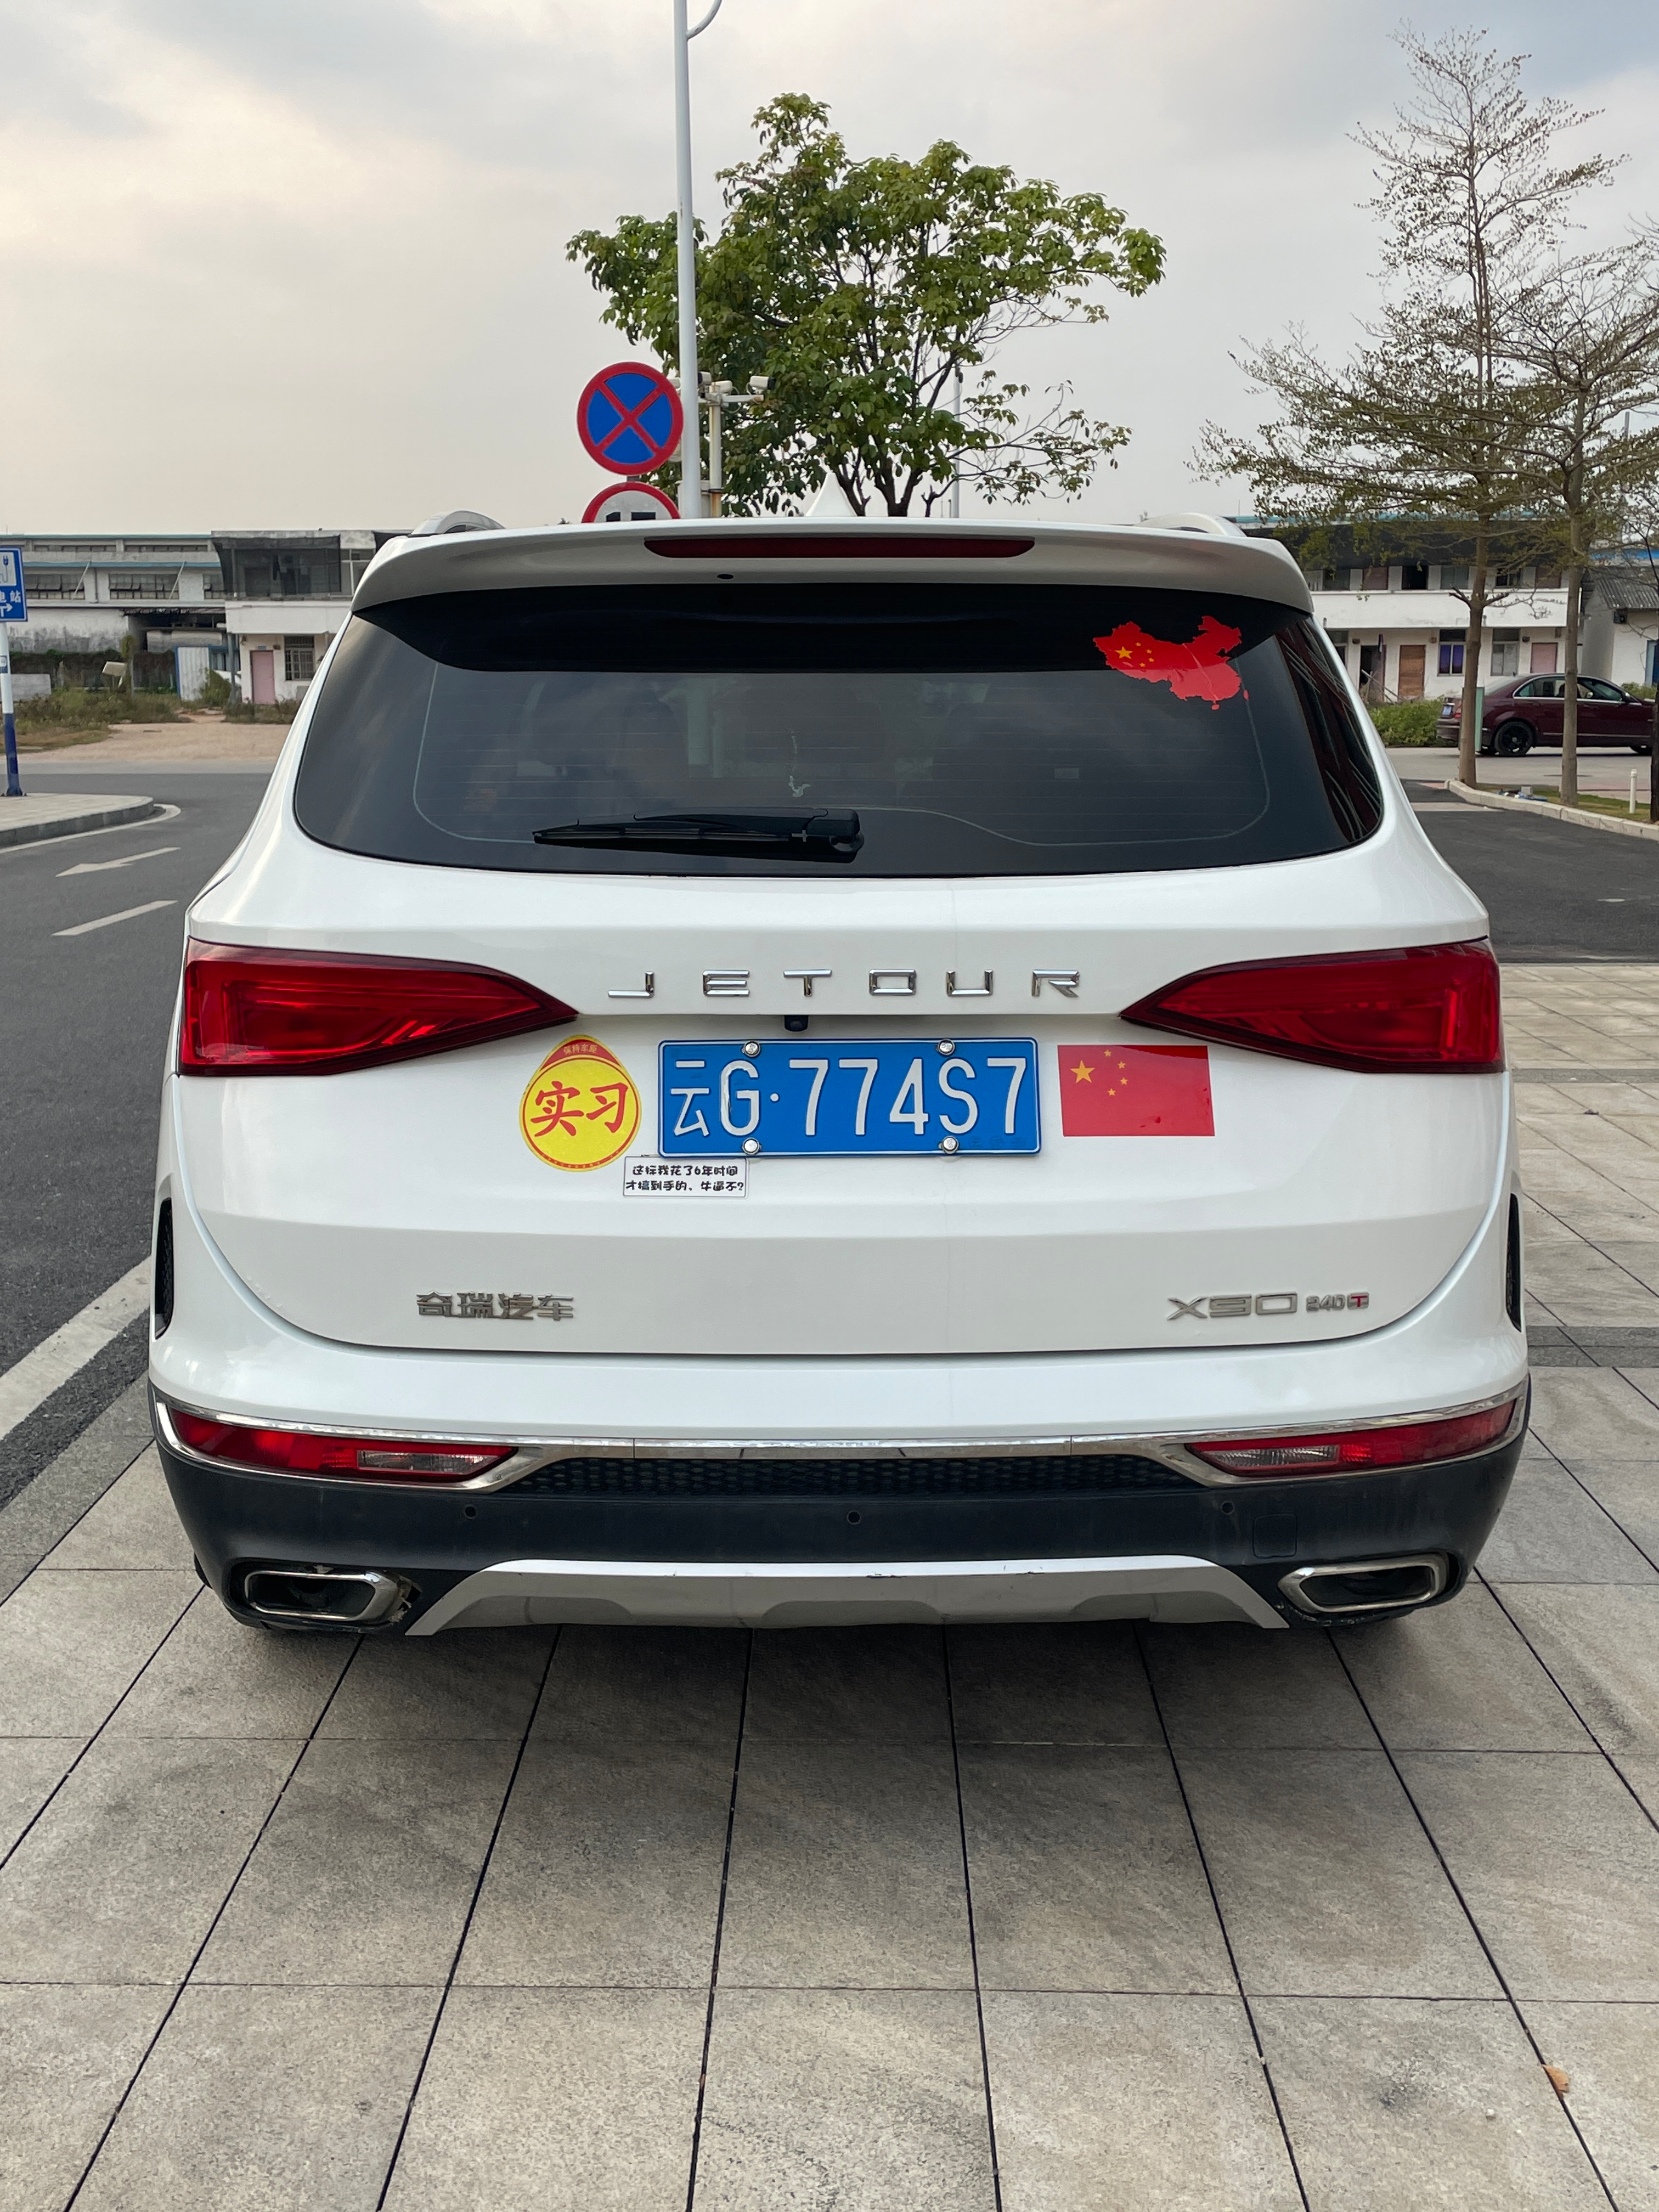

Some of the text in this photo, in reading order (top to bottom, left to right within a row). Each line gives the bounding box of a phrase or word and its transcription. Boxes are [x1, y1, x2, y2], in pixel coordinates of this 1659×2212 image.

[607, 969, 1080, 998] JETOUR
[563, 1043, 598, 1054] 保持车距
[530, 1080, 629, 1137] 实习
[633, 1165, 738, 1176] 这标我花了6年时间
[416, 1290, 573, 1321] 奇瑞汽车
[1167, 1291, 1297, 1321] X90
